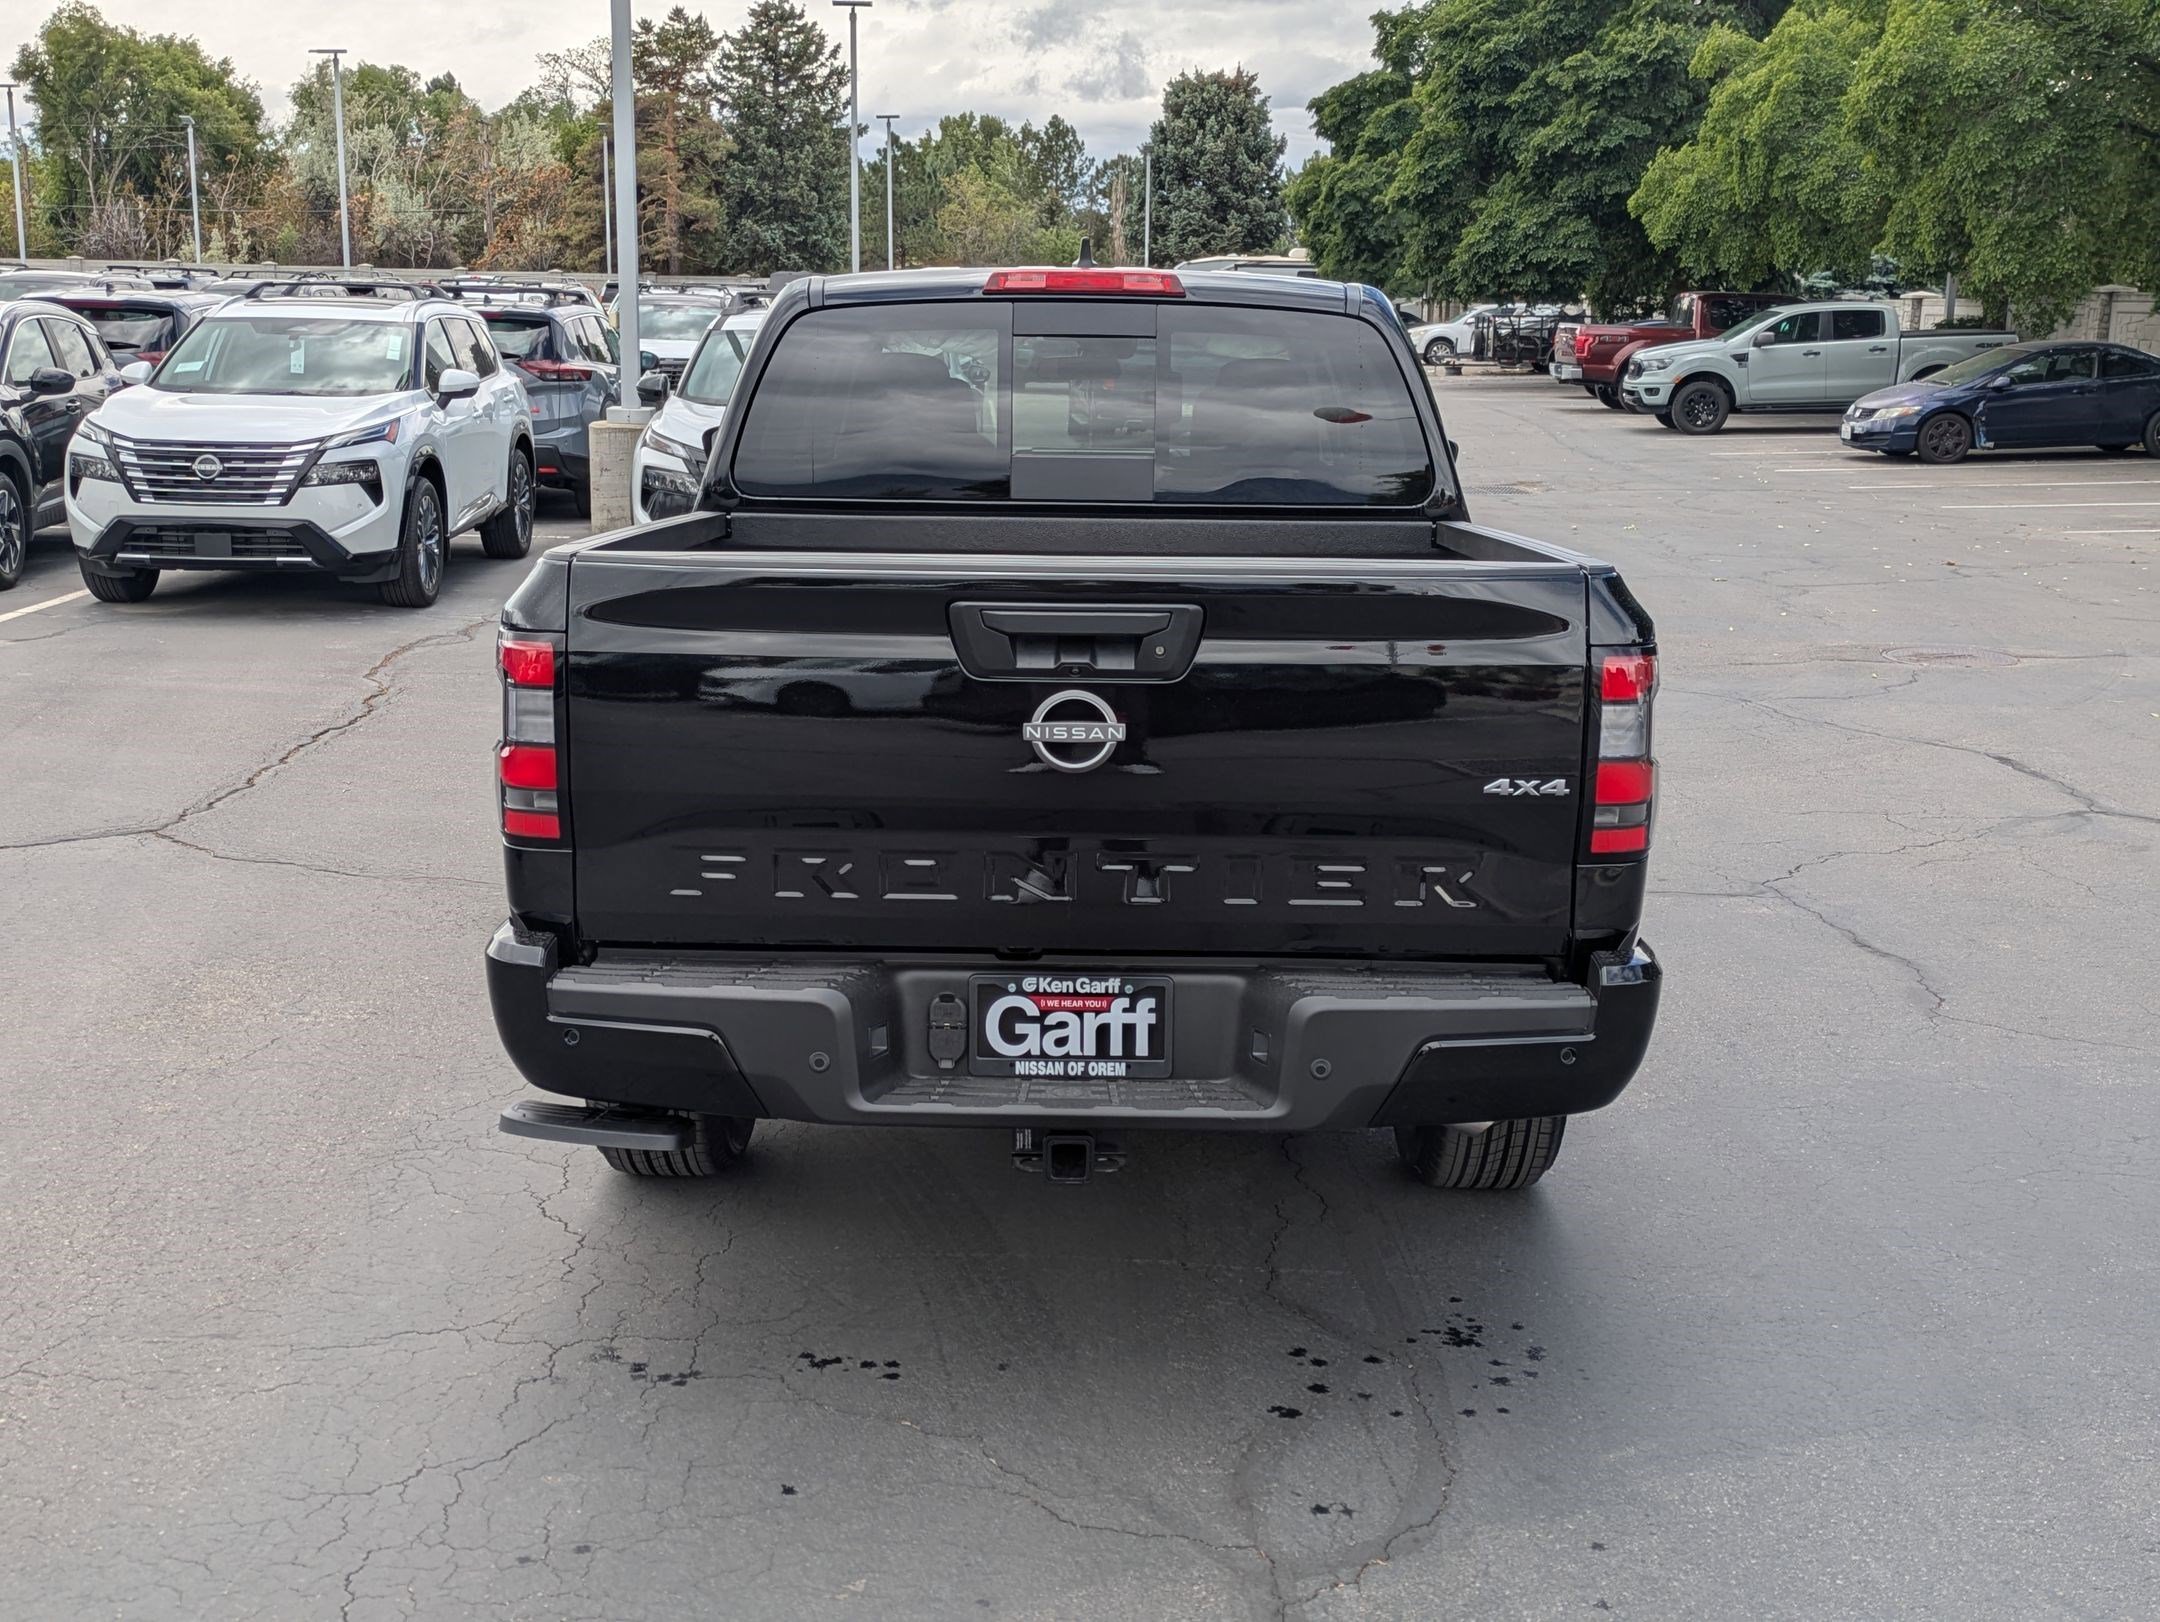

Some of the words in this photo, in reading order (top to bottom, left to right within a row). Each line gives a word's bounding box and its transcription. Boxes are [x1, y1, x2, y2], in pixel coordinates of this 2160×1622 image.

[1025, 726, 1123, 739] NISSAN
[669, 845, 1479, 908] FRONTIER
[1038, 977, 1075, 993] Ken
[1075, 977, 1121, 994] Garff
[1047, 1000, 1060, 1008] WE
[1061, 1000, 1083, 1008] HEAR
[1084, 1000, 1102, 1008] YOU
[985, 995, 1157, 1057] Garff
[1015, 1061, 1064, 1076] NISSAN
[1067, 1062, 1086, 1076] OF
[1088, 1062, 1127, 1077] OREM
